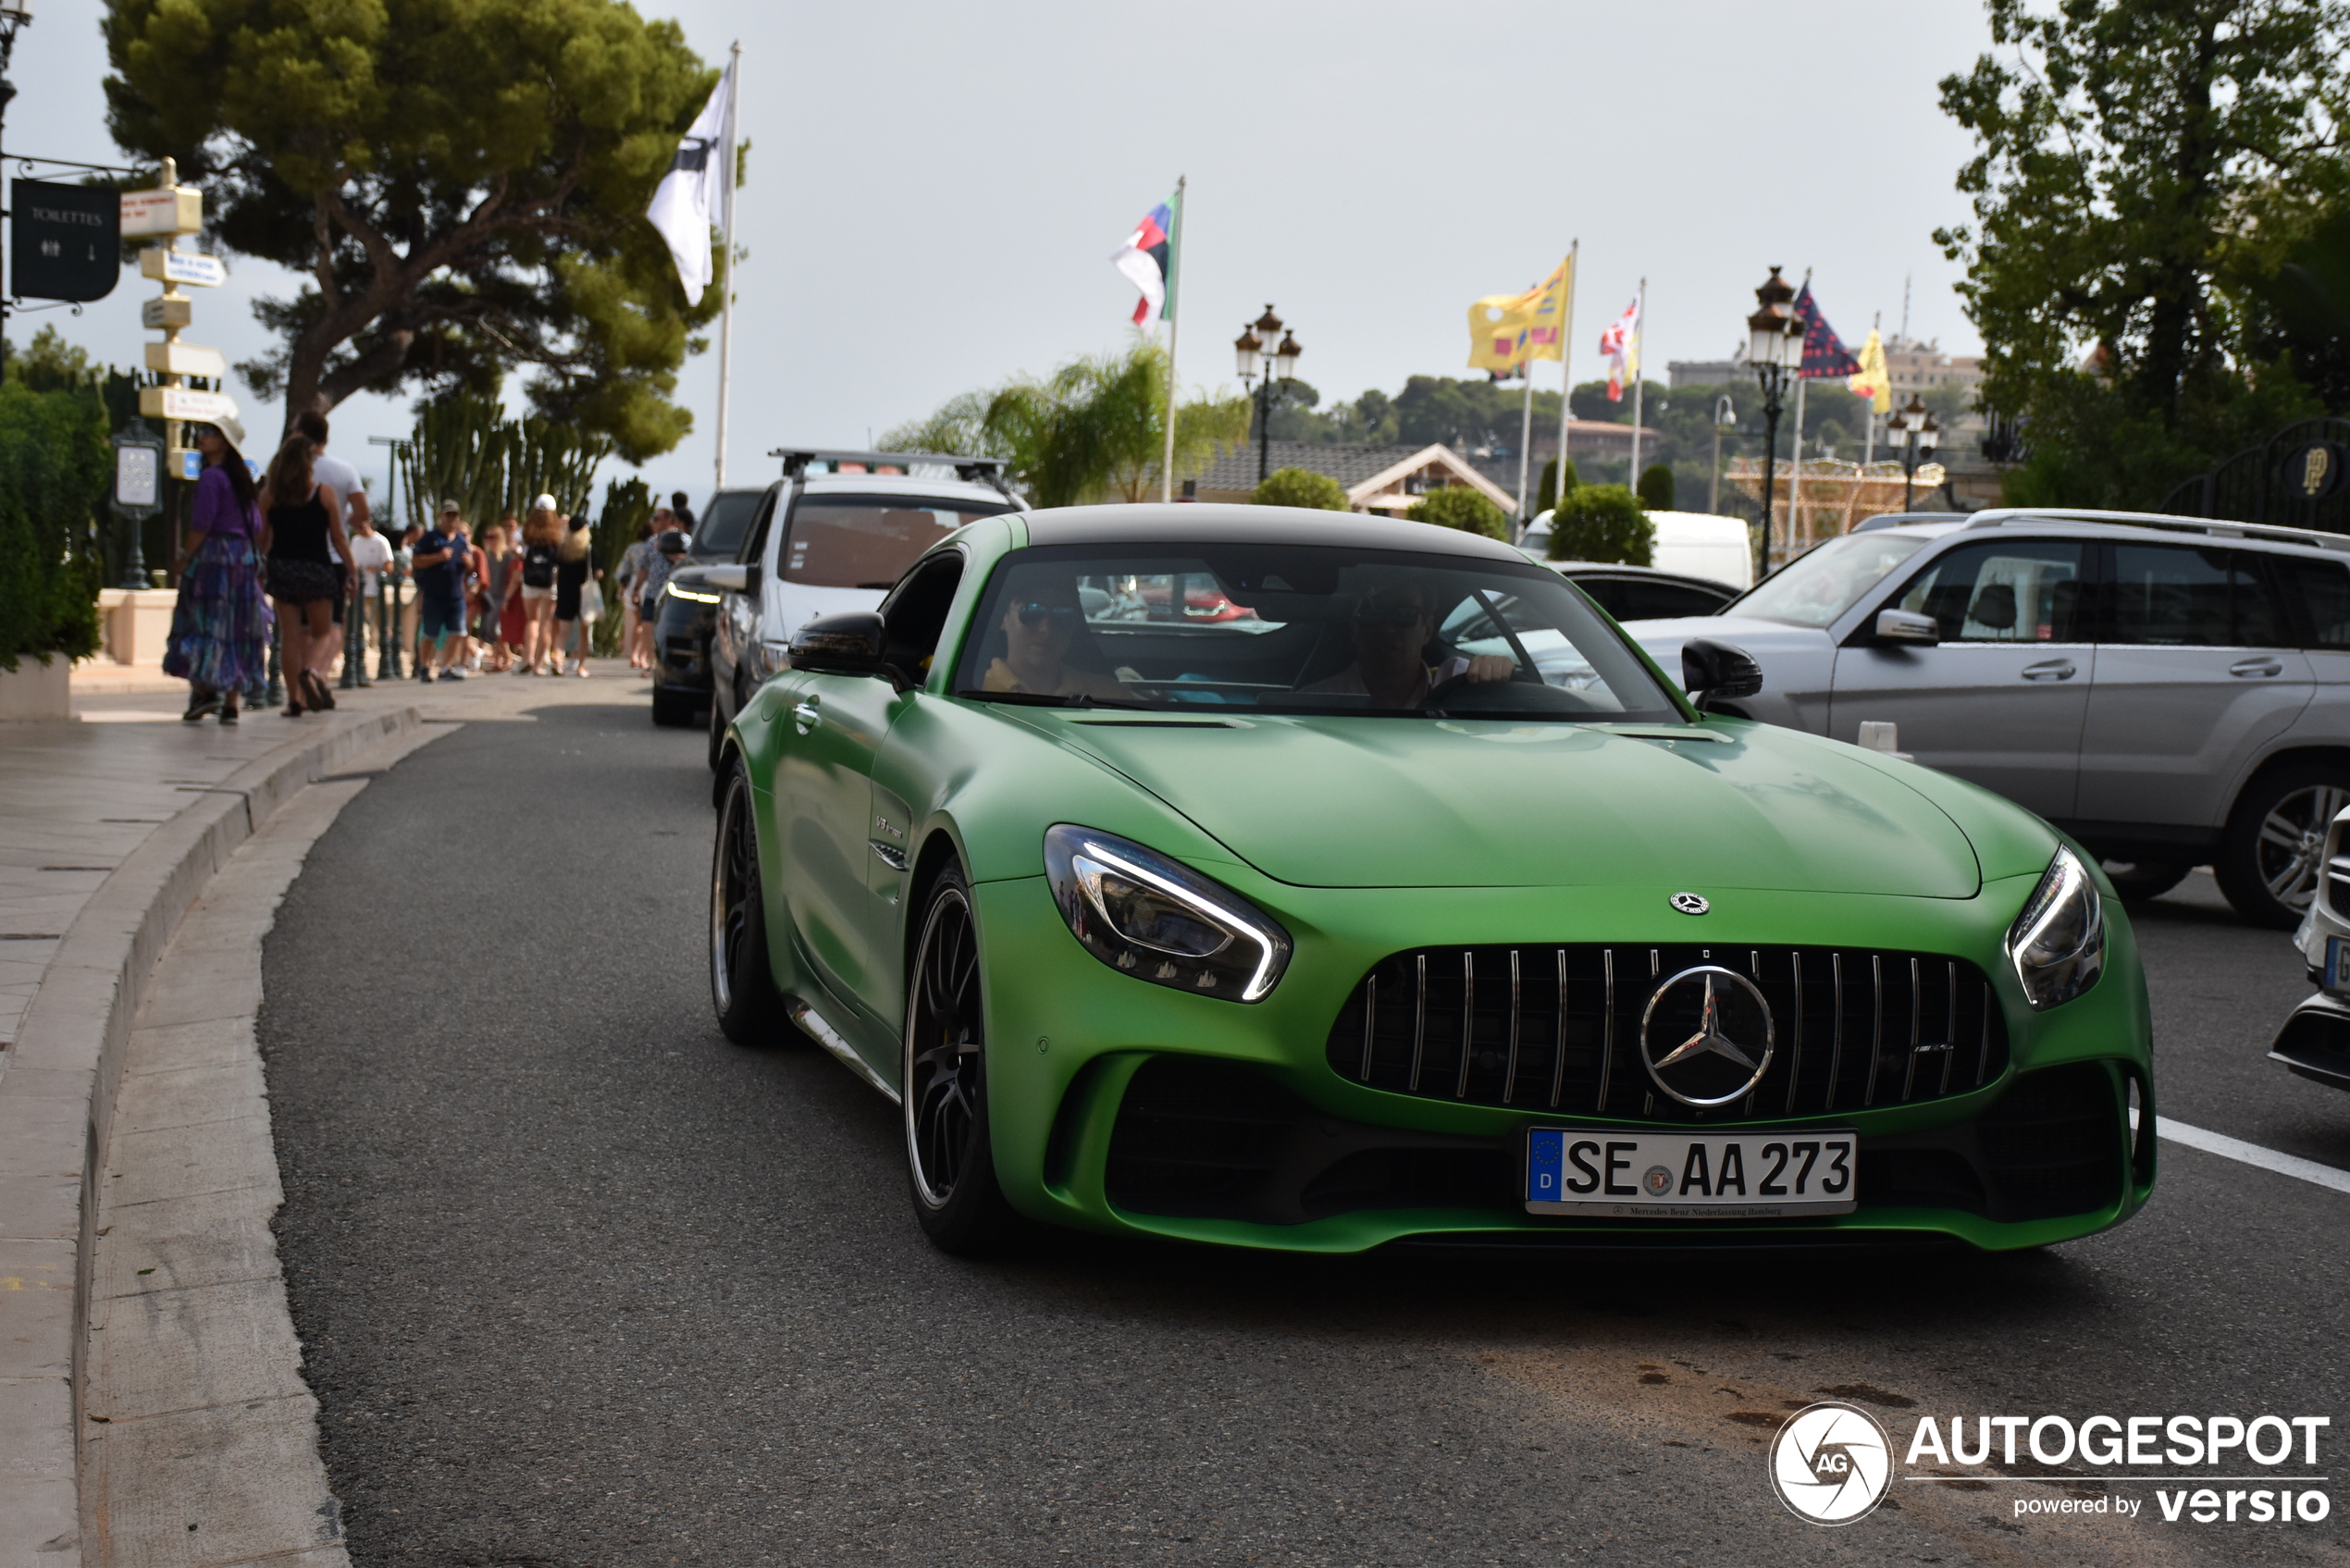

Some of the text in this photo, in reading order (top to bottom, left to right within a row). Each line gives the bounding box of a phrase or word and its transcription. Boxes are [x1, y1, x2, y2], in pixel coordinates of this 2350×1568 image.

[31, 206, 103, 228] TOILETTES
[1540, 1173, 1552, 1190] D
[1565, 1140, 1638, 1195] SE
[1678, 1142, 1747, 1196] AA
[1759, 1141, 1851, 1195] 273
[1629, 1206, 1782, 1217] Mercedes-Benz Niederlassung Hamburg
